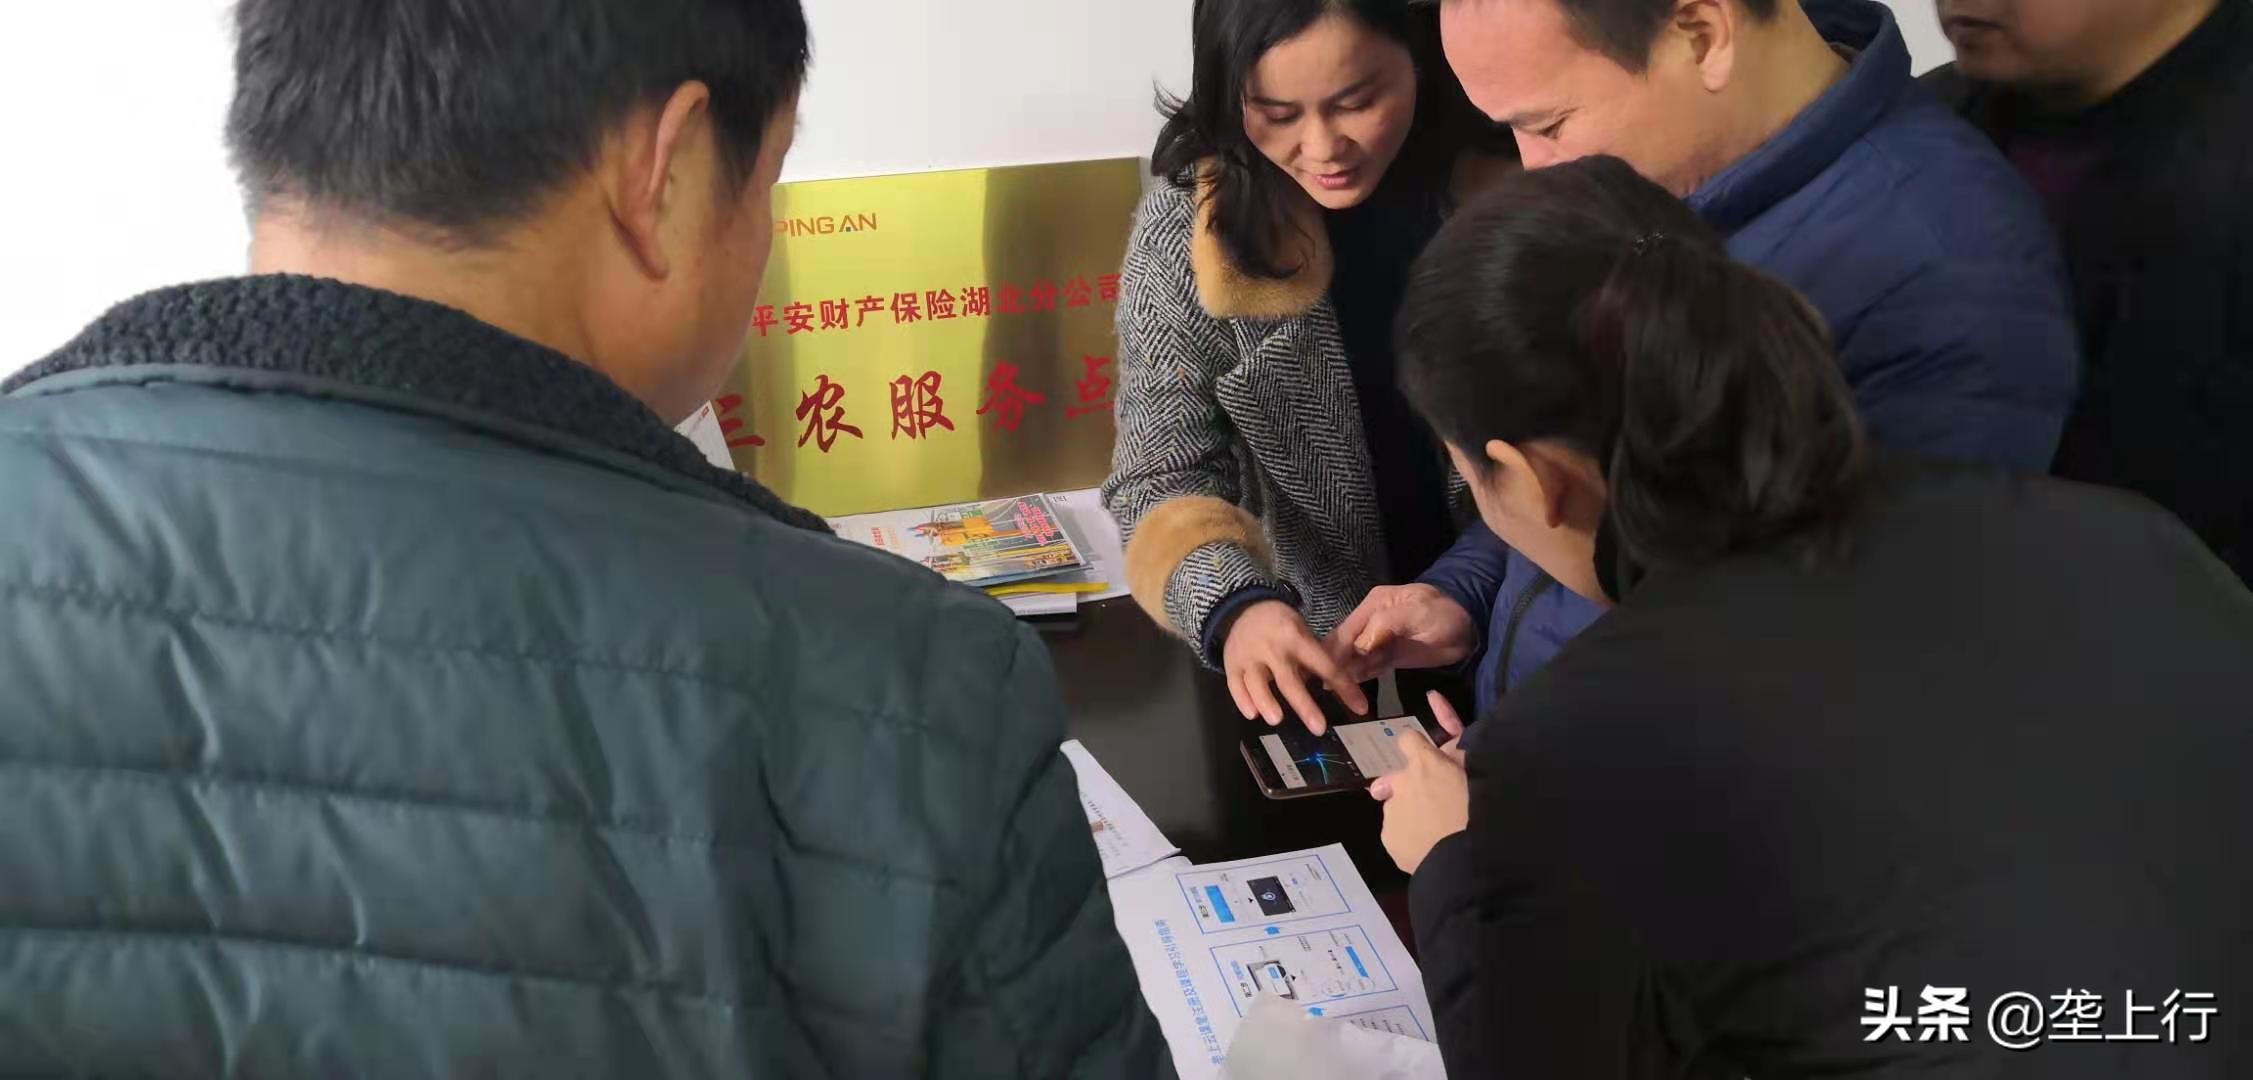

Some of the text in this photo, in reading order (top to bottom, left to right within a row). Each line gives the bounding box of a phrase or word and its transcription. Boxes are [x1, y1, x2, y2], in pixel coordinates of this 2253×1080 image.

[752, 273, 1121, 337] 平安财产保险湖北分公司
[715, 353, 1115, 453] 三农服务点
